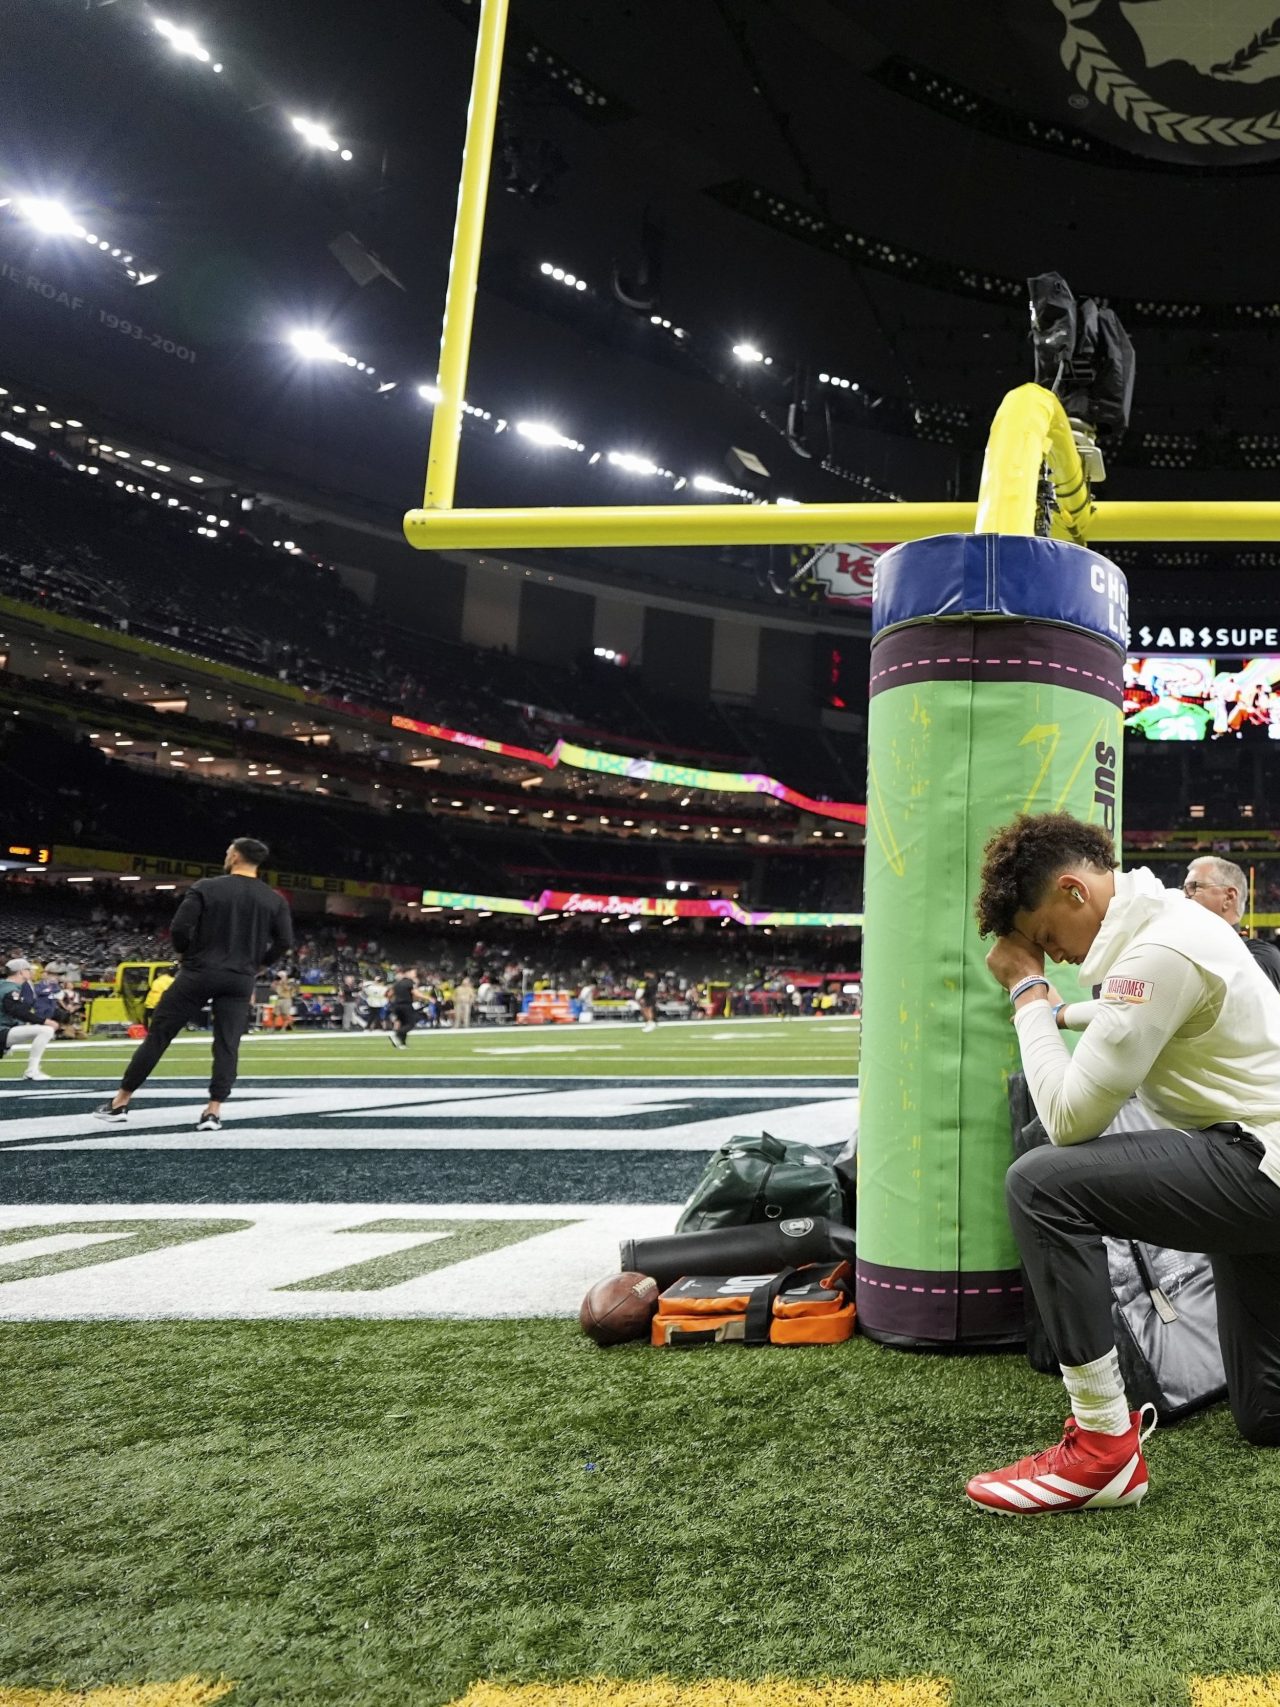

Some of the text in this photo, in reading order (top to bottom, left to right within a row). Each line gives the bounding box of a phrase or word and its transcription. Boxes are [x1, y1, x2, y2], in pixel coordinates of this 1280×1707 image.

[26, 275, 84, 310] ROAF
[99, 310, 197, 364] 1993-2001
[37, 849, 49, 862] 3
[641, 898, 678, 916] LIX
[1107, 978, 1145, 998] MAHOMES
